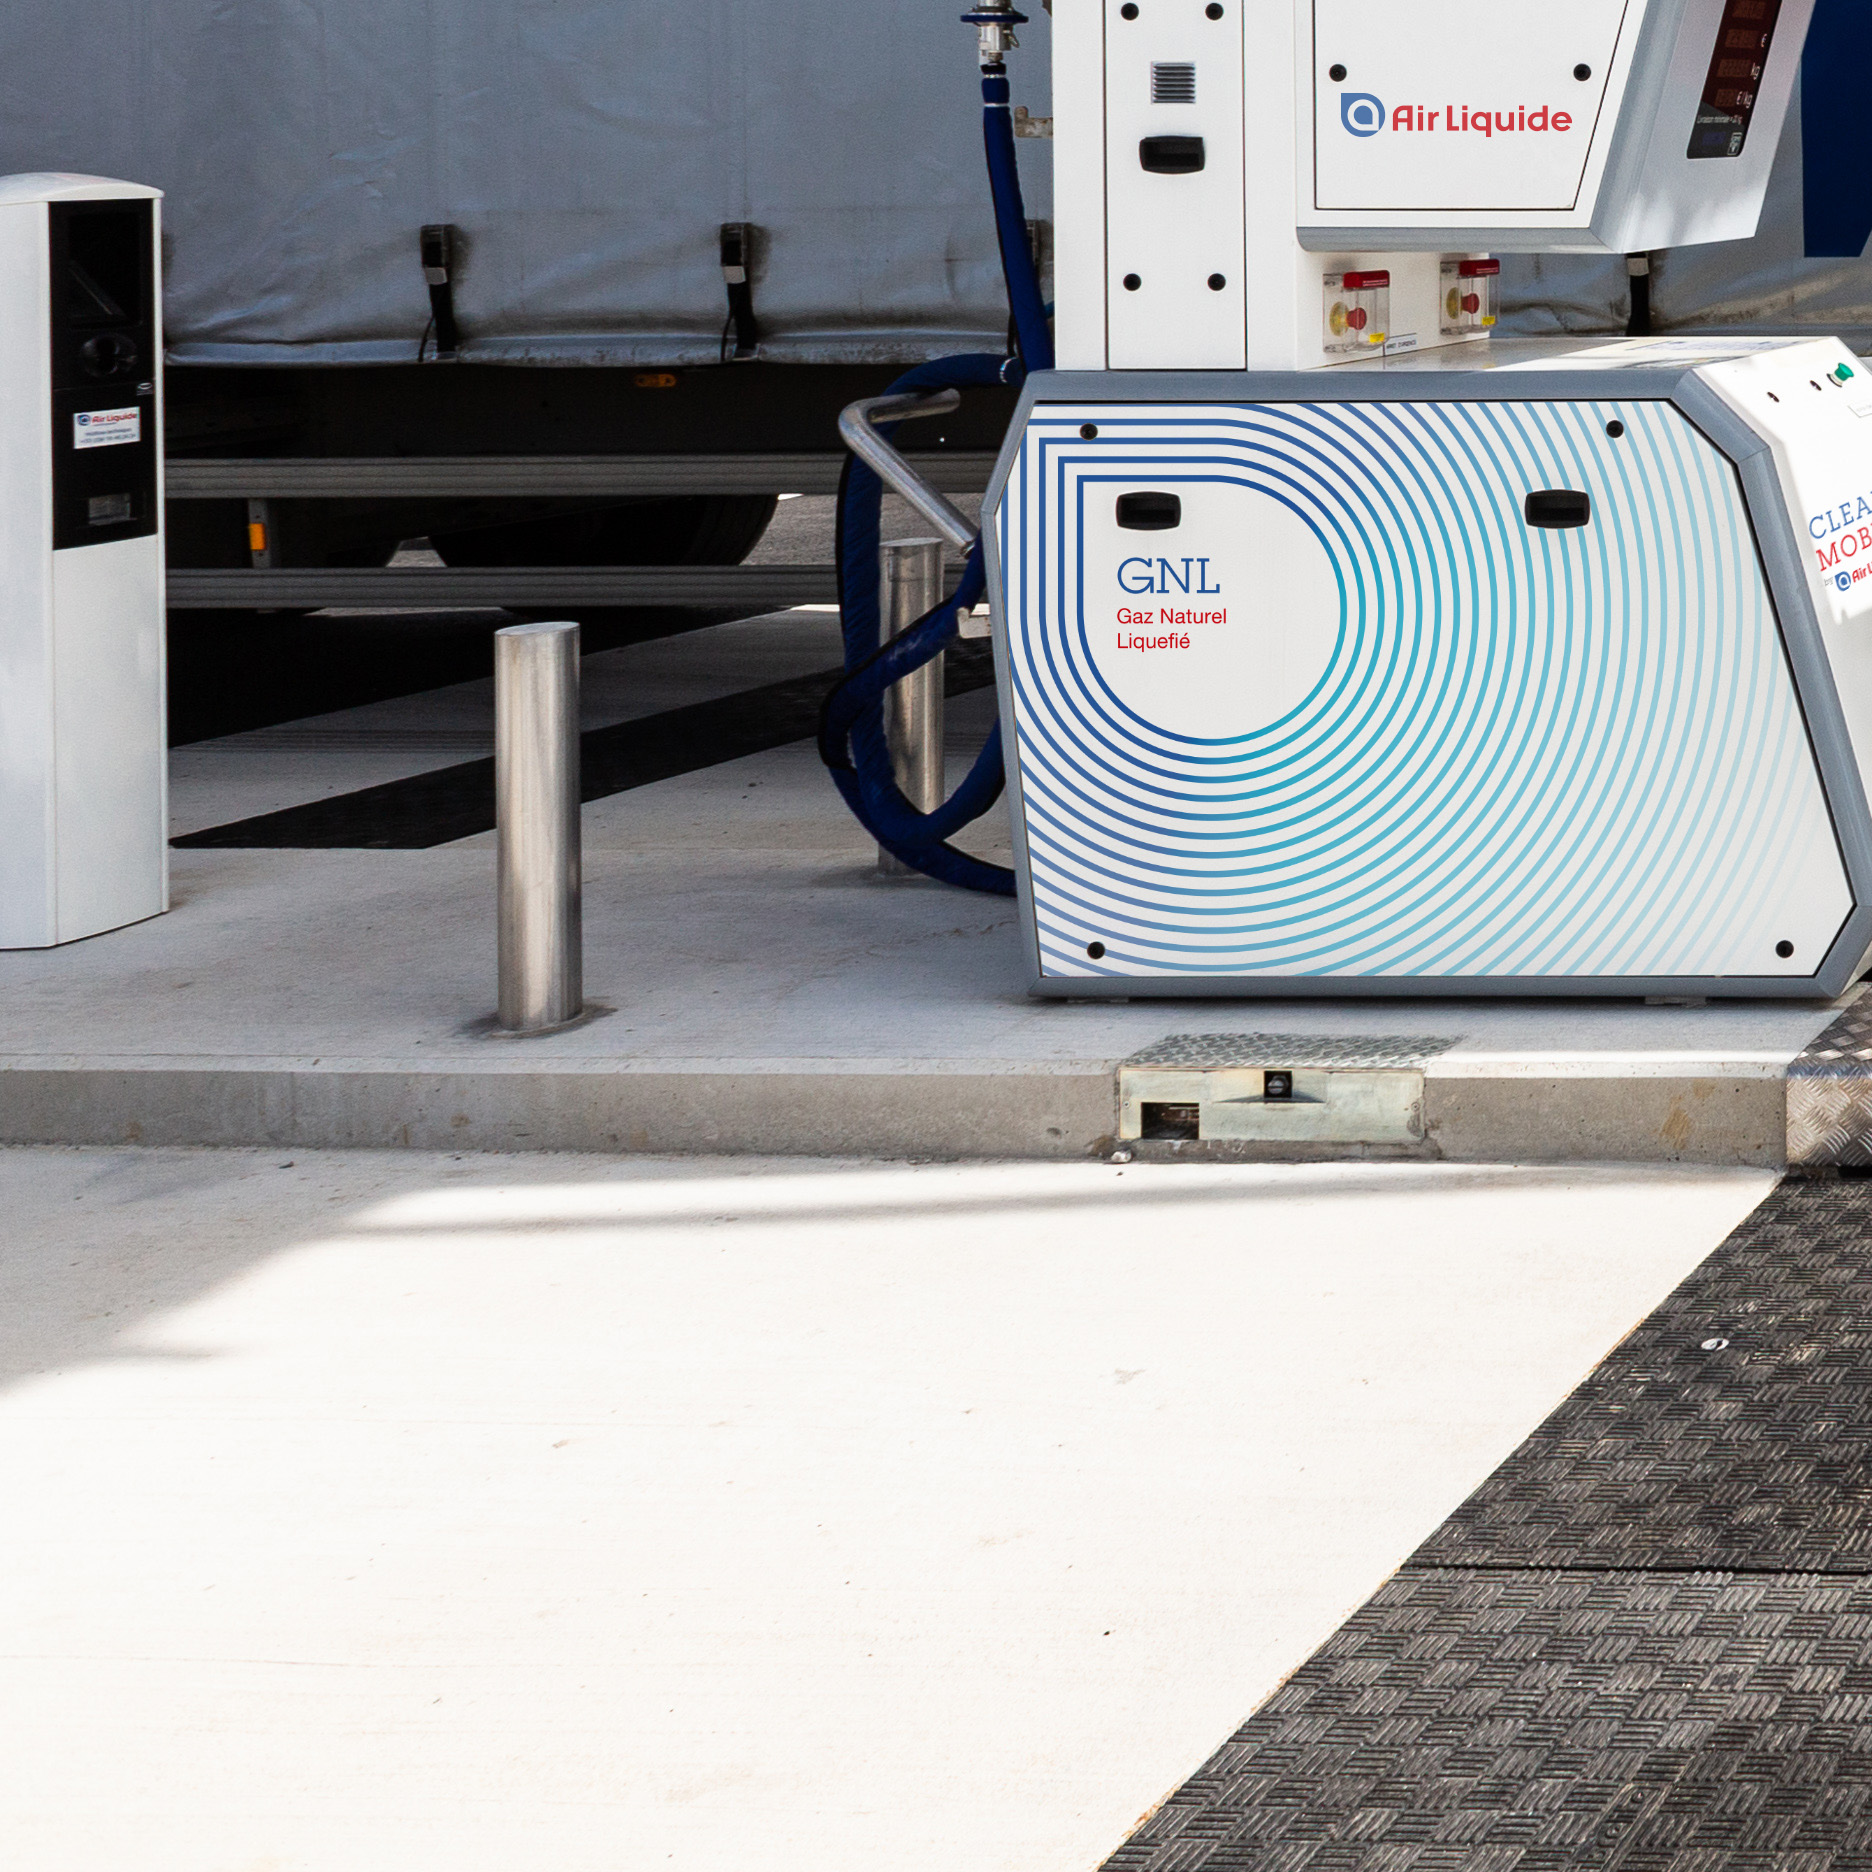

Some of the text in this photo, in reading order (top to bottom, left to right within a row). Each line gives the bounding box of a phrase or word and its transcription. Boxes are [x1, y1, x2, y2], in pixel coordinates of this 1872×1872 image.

[1392, 105, 1573, 138] Air Liquide
[92, 412, 137, 423] Air Liquide
[1117, 557, 1221, 594] GNL
[1852, 567, 1867, 583] Air
[1117, 607, 1227, 624] Gaz Naturel
[1117, 632, 1190, 653] Liquefié
